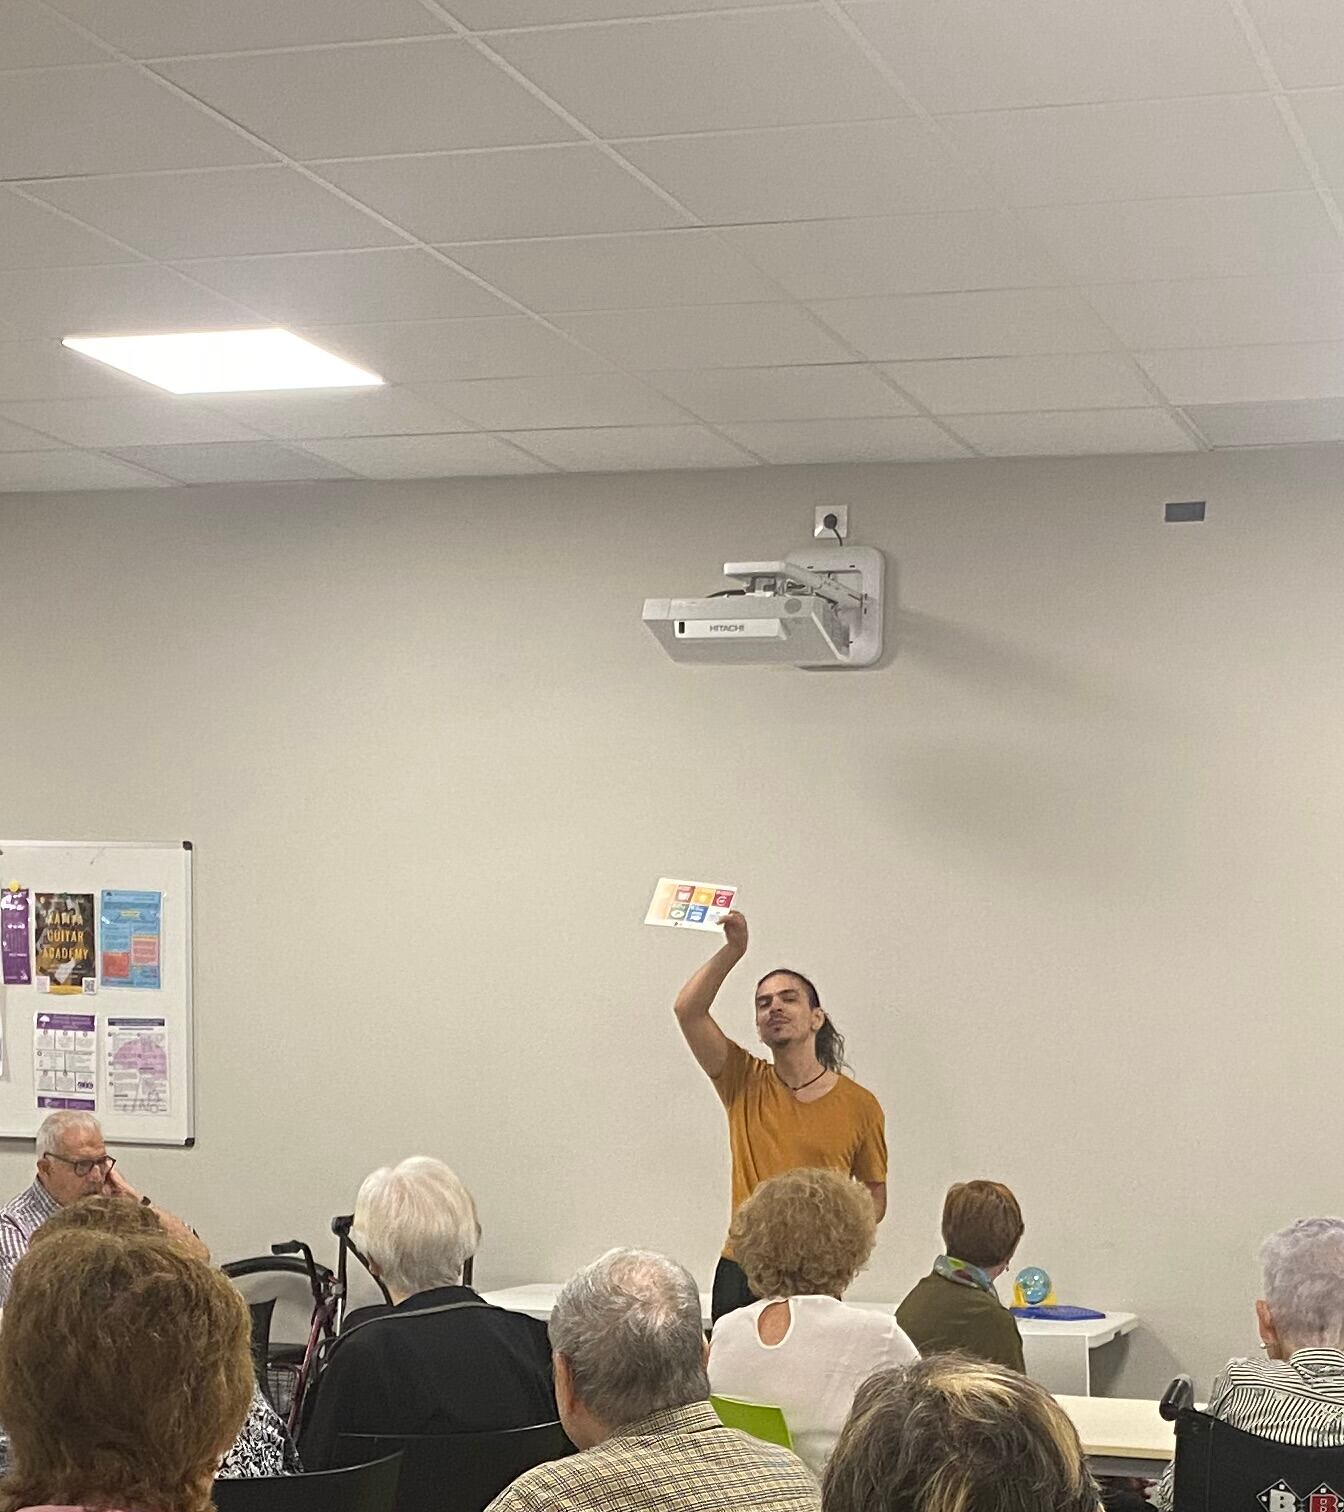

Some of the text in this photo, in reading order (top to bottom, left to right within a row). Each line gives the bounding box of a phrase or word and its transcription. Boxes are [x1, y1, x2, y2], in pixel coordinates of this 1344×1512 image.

[709, 624, 745, 632] HITACHI
[47, 929, 84, 942] GUITAR
[42, 946, 89, 961] ACADEMY
